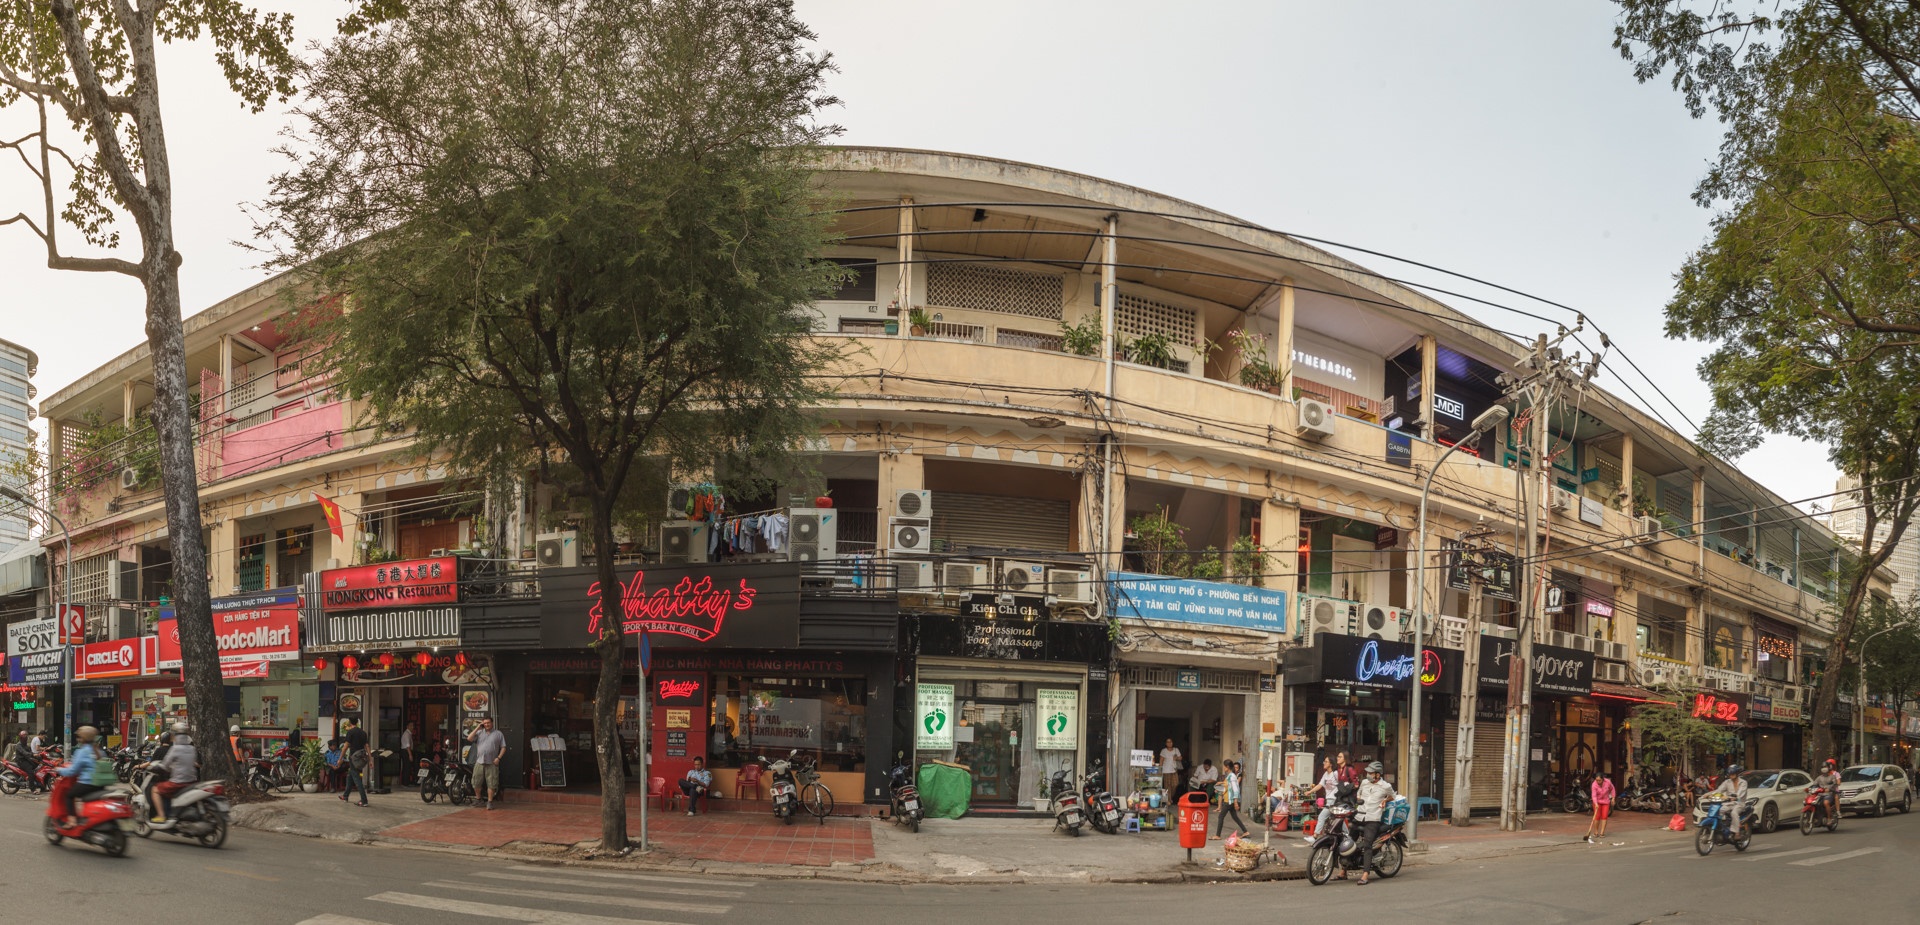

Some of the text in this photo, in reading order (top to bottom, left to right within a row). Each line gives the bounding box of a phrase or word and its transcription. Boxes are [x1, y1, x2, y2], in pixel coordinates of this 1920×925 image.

[1387, 442, 1411, 455] GABBYN
[327, 583, 452, 605] HONGKONG Restaurant
[1140, 581, 1157, 592] DÂN
[1160, 584, 1176, 594] KHU
[1179, 584, 1196, 596] PHỐ
[1197, 588, 1203, 597] 6
[1209, 588, 1240, 601] PHƯỜNG
[1242, 591, 1258, 603] BẾN
[257, 596, 276, 605] TP.HCM
[235, 611, 248, 621] HÀNG
[1019, 605, 1039, 617] Gia
[1145, 600, 1163, 610] TÂM
[1167, 600, 1182, 611] GIỮ
[1184, 602, 1206, 614] VỮNG
[1208, 606, 1225, 616] KHU
[1227, 606, 1244, 618] PHỐ
[1245, 609, 1261, 620] VĂN
[1262, 610, 1278, 622] HÓA
[651, 622, 667, 631] BAR
[679, 625, 700, 638] GRILL
[974, 622, 1037, 637] Professional
[966, 636, 1044, 649] Foot Massage
[87, 645, 133, 666] CIRCLE K
[1356, 640, 1425, 682] Overtim
[1494, 641, 1584, 685] Hgover
[25, 674, 36, 682] NHÀ
[1181, 675, 1197, 683] 42
[659, 679, 700, 695] Phatty's
[1773, 706, 1801, 719] BELCO
[1332, 716, 1348, 731] Tiger
